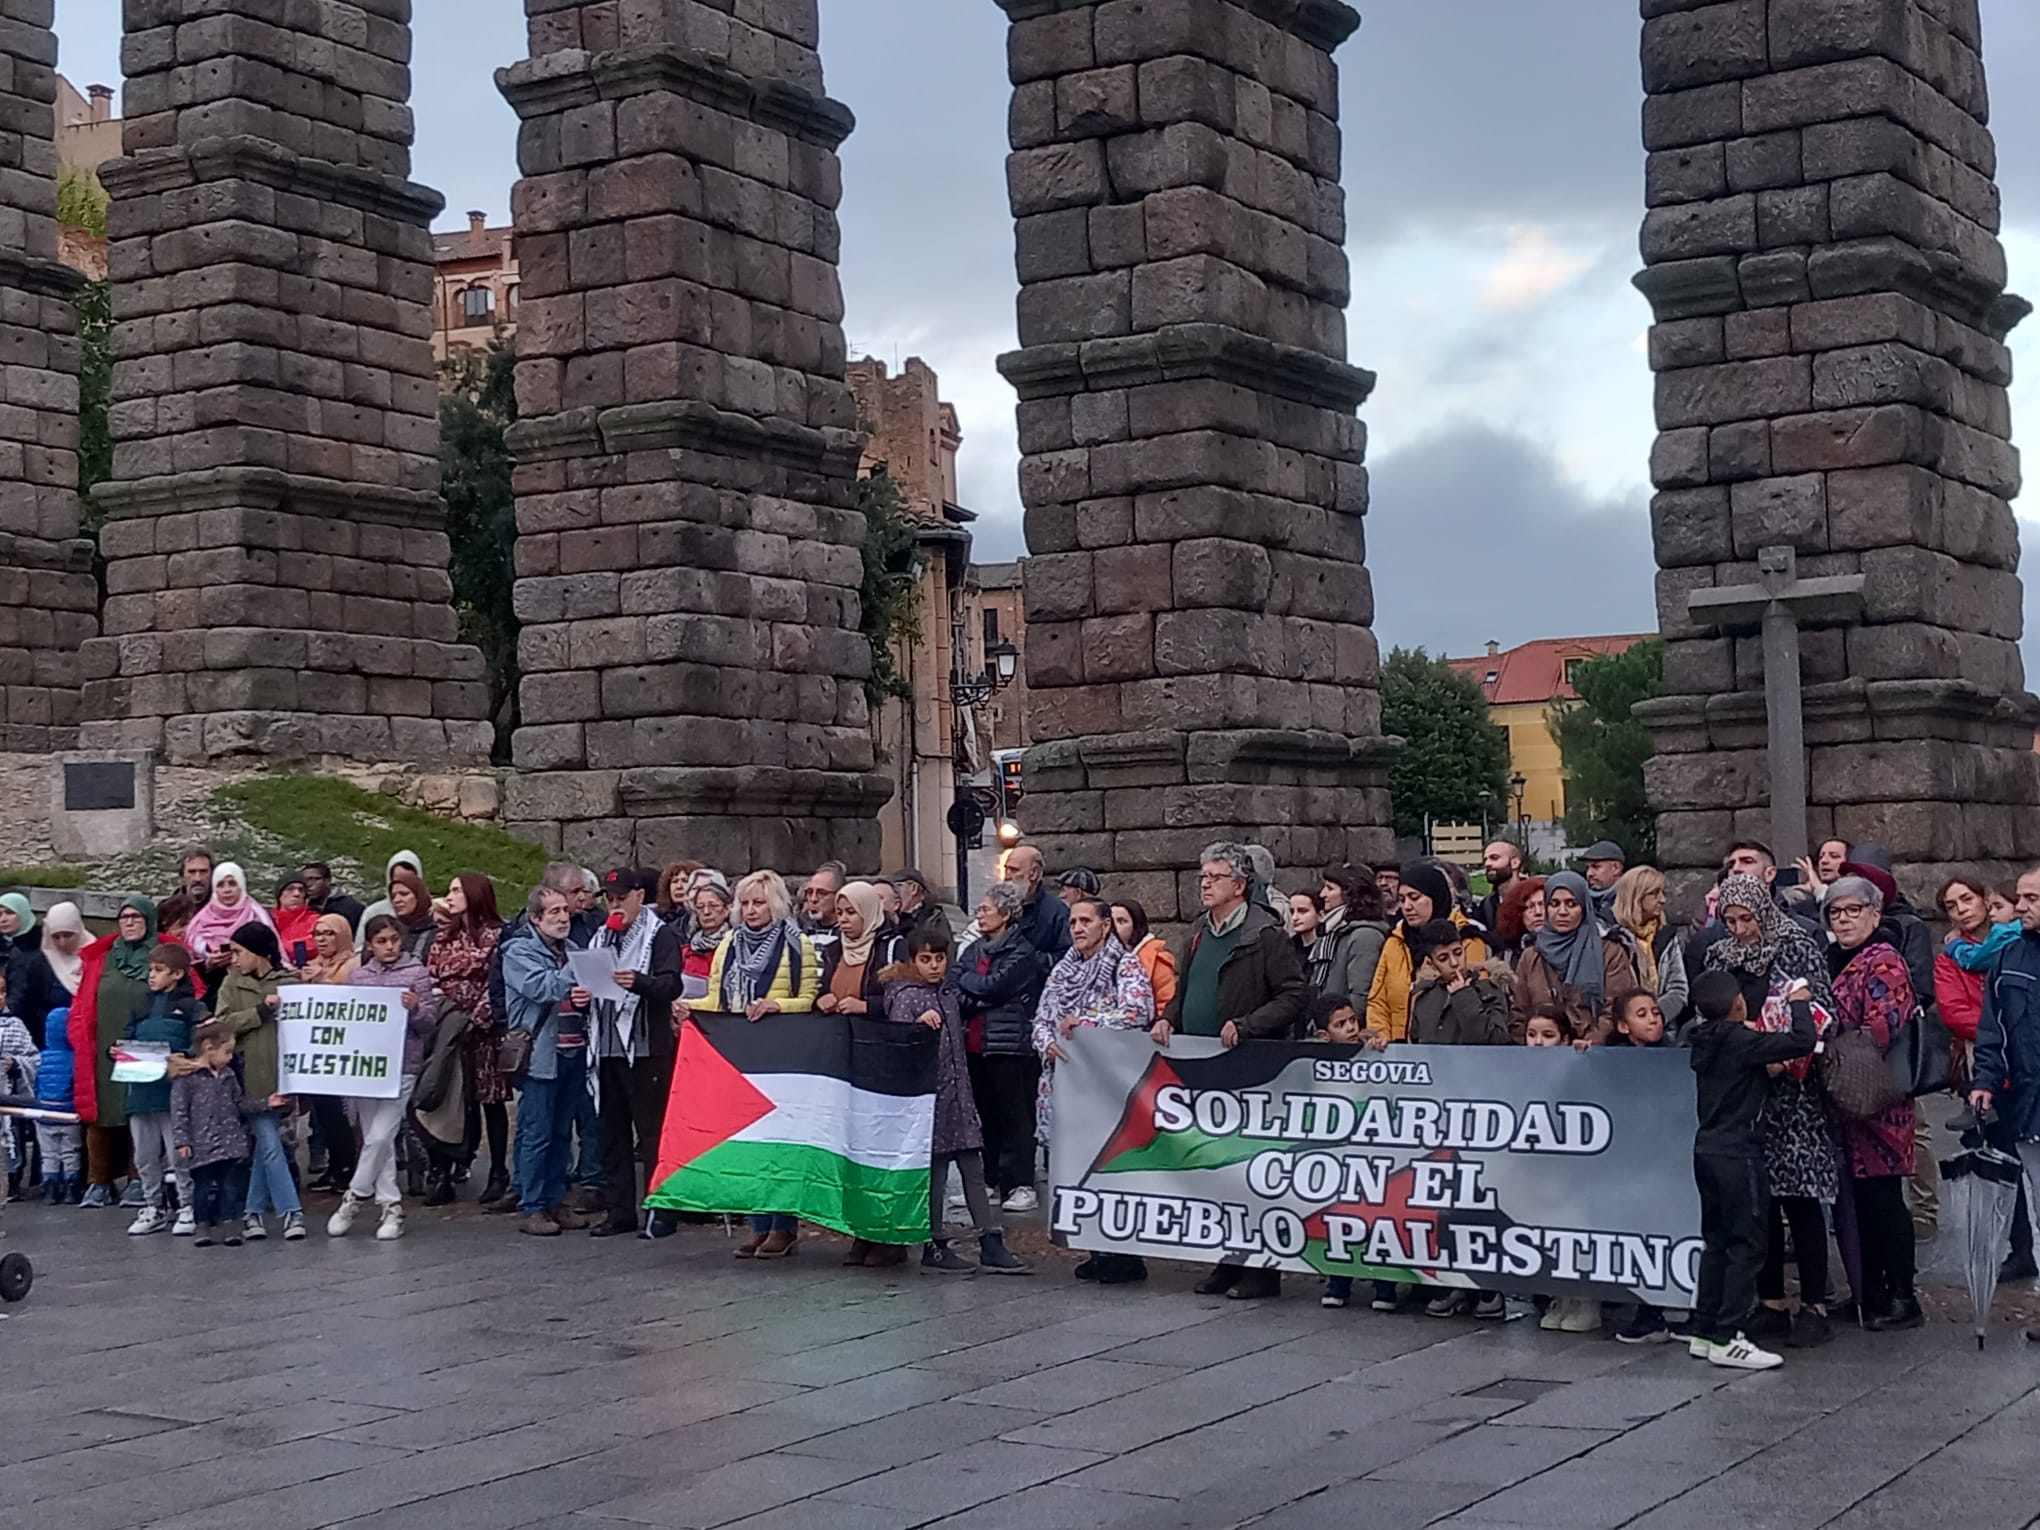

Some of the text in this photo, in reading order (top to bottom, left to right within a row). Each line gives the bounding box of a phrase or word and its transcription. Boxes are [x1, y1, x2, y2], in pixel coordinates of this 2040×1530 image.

[310, 1026, 346, 1045] CON
[1314, 1060, 1432, 1084] SEGOVIA
[1154, 1085, 1613, 1153] SOLIDARIDAD
[1248, 1150, 1498, 1211] CON EL
[1053, 1187, 1306, 1257] PUEBLO
